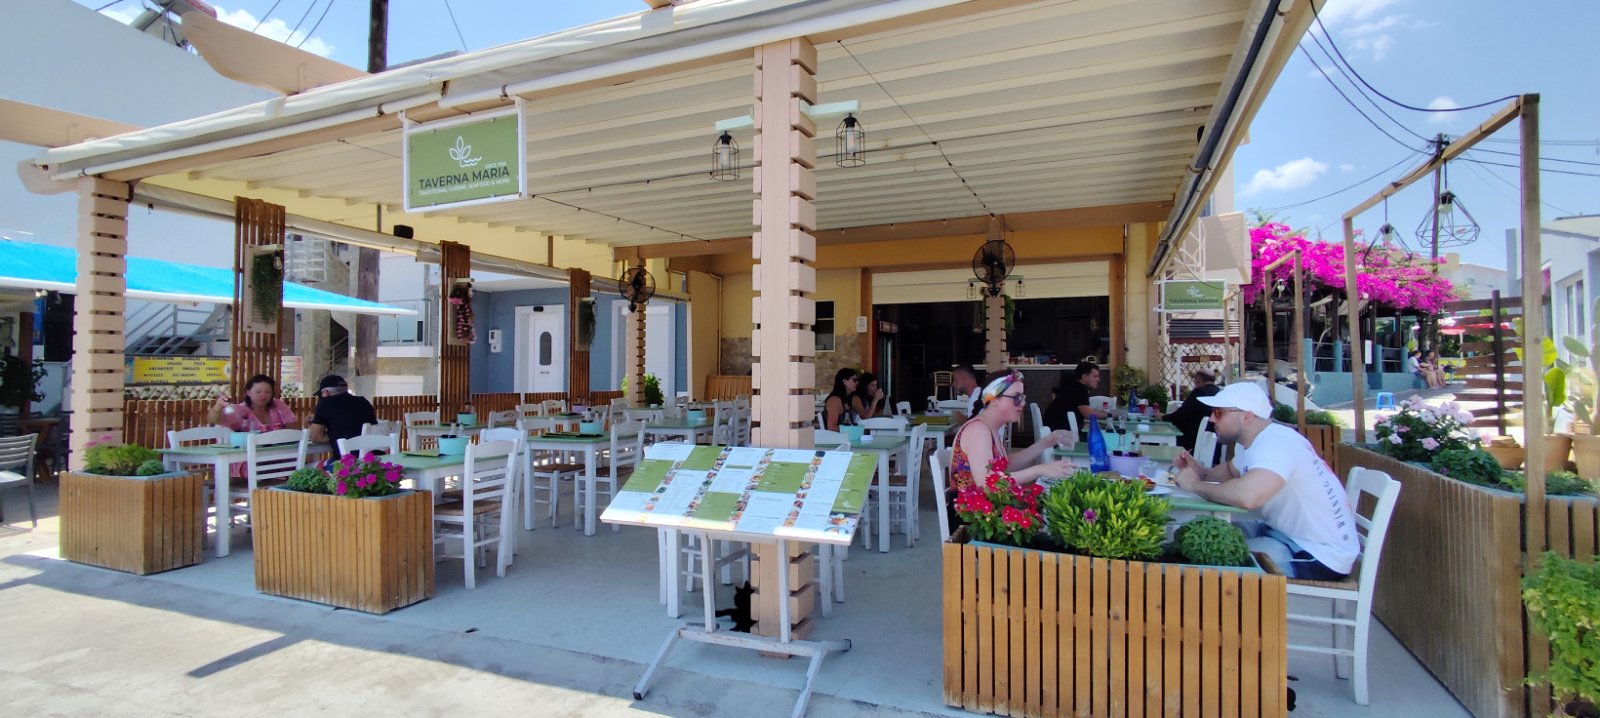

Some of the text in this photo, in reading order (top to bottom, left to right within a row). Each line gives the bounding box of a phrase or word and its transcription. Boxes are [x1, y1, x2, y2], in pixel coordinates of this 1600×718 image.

[418, 166, 510, 189] TAVERNA MARIA
[1323, 480, 1346, 529] WINNING
